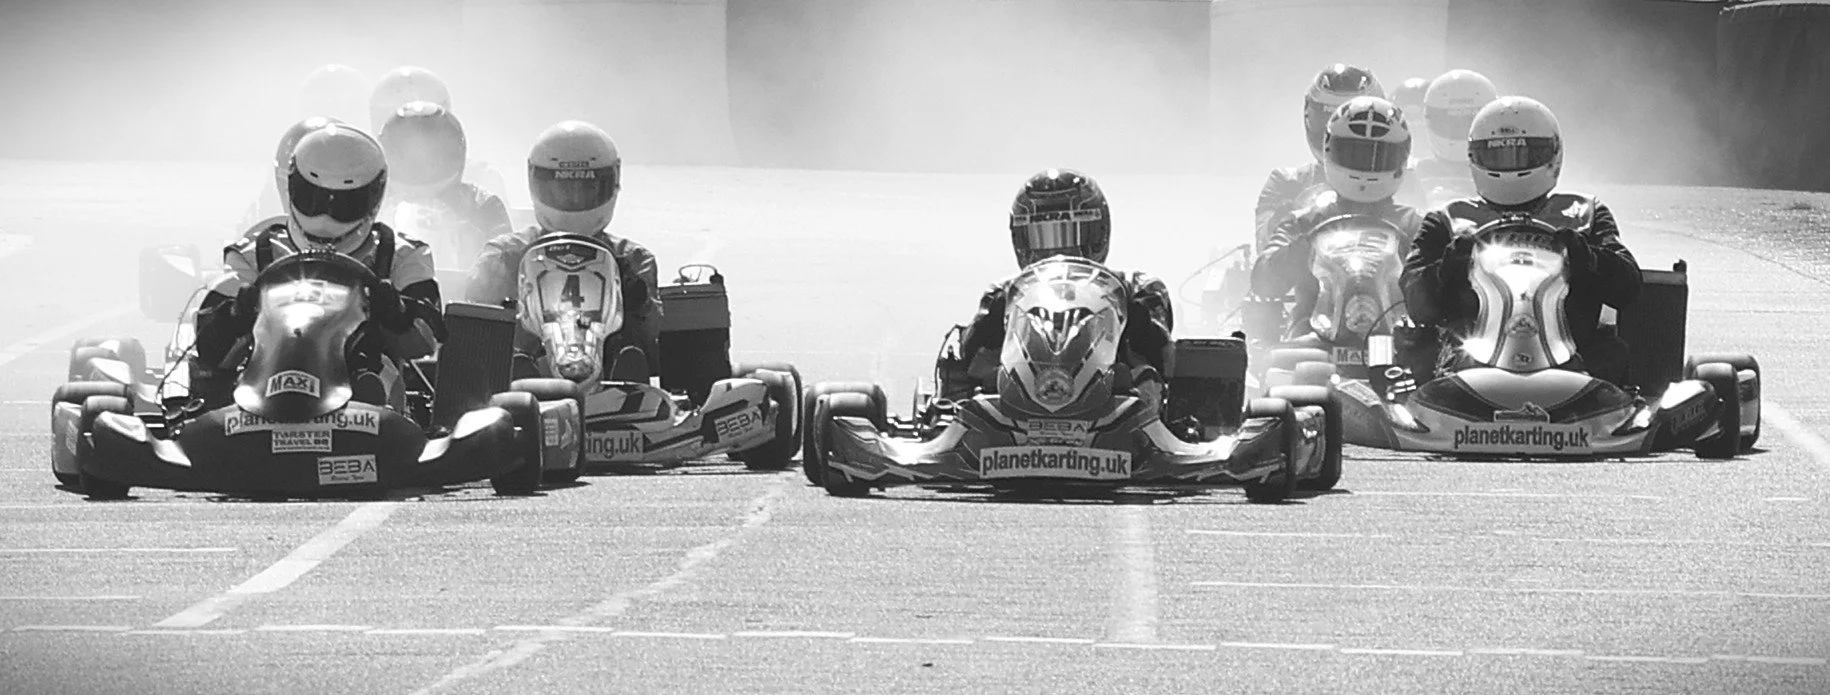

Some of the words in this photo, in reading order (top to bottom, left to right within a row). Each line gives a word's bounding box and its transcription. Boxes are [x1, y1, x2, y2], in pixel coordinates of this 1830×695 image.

[717, 410, 761, 436] BEBA
[1029, 420, 1085, 432] BEBA
[1454, 425, 1589, 450] planetkarting.uk
[319, 460, 375, 475] BEBA
[983, 449, 1128, 476] planetkarting.uk
